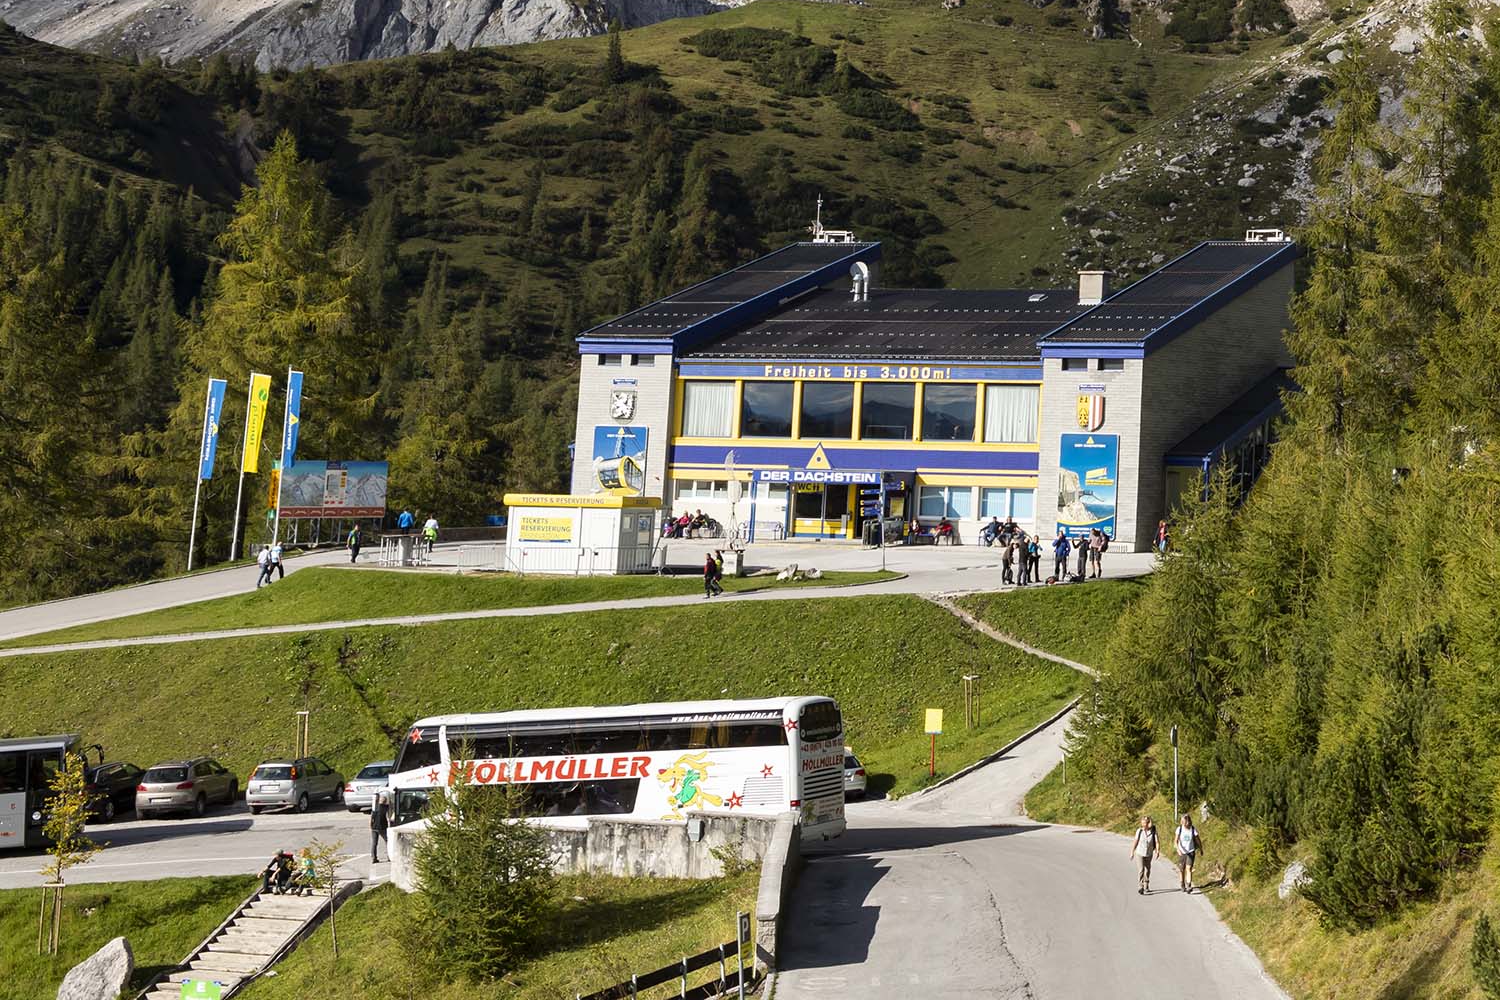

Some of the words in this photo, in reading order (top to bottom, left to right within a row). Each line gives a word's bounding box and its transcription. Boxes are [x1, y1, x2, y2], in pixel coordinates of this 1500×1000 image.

[764, 365, 832, 378] Freiheit
[843, 366, 868, 379] bis
[760, 470, 789, 481] DER
[793, 471, 876, 483] DACHSTEIN
[797, 482, 812, 491] WC
[522, 496, 548, 504] TICKETS
[556, 497, 604, 505] RESERVIERUNG
[742, 917, 749, 942] P
